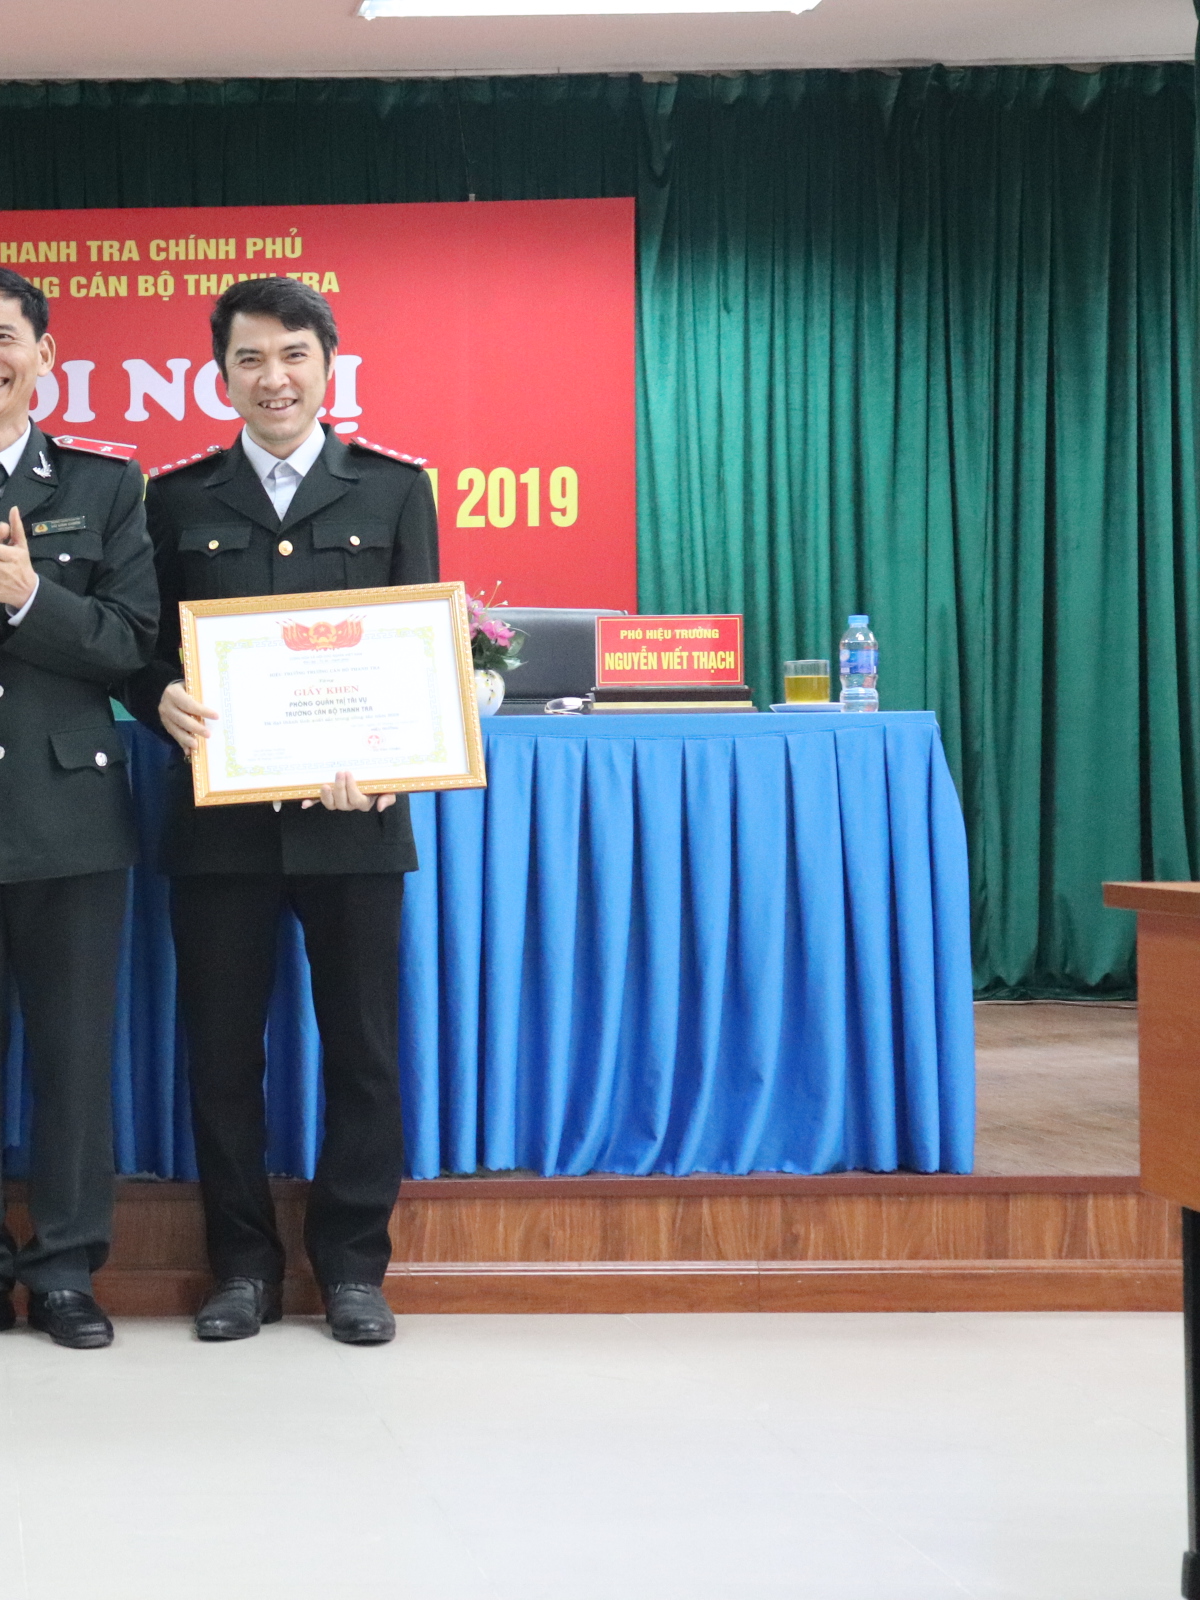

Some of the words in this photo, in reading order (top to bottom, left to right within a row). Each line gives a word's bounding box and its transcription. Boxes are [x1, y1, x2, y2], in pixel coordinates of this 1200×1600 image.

[86, 239, 139, 262] TRA
[149, 234, 241, 261] CHÍNH
[246, 227, 303, 259] PHỦ
[69, 271, 129, 297] CÁN
[137, 270, 176, 301] BỘ
[456, 466, 579, 529] 2019
[620, 627, 643, 640] PHÓ
[646, 627, 672, 641] HIỆU
[605, 646, 658, 671] NGUYỄN
[661, 646, 689, 670] VIẾT
[692, 651, 735, 673] THẠCH
[294, 684, 322, 697] GIẤY
[326, 685, 359, 695] KHEN
